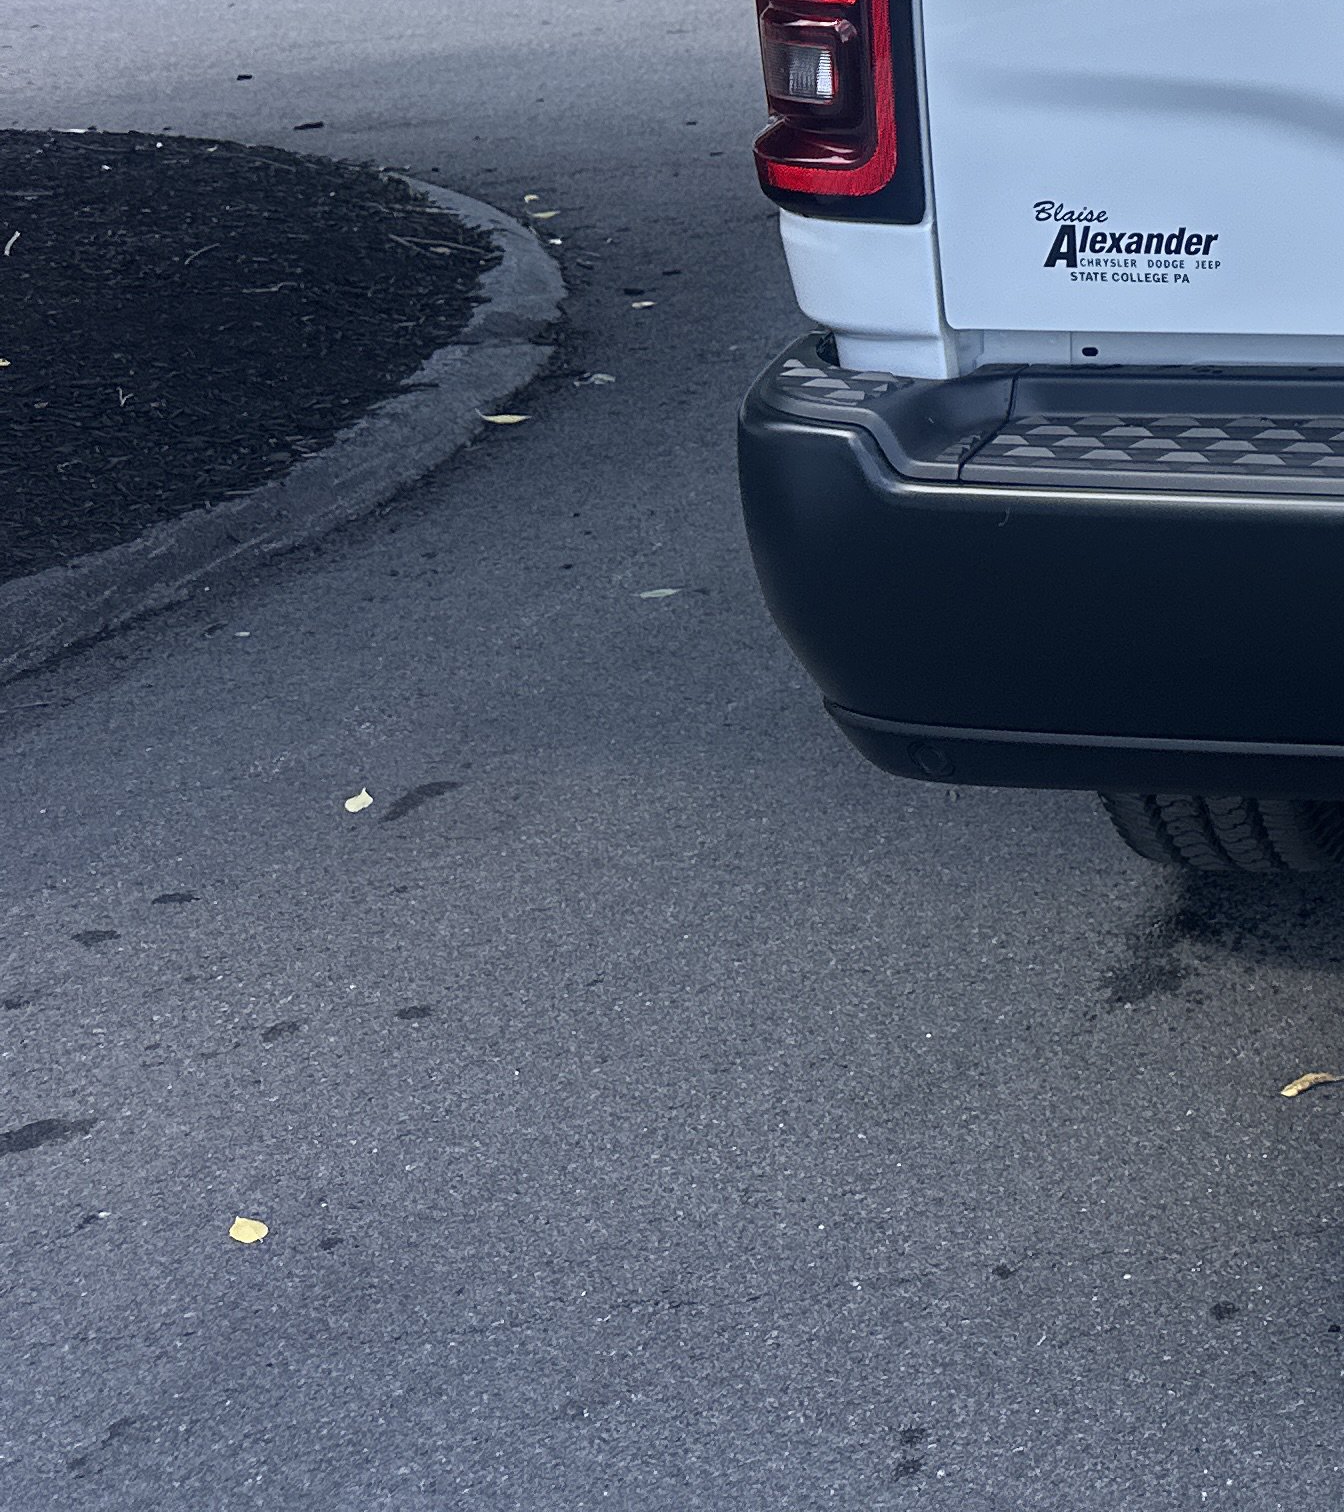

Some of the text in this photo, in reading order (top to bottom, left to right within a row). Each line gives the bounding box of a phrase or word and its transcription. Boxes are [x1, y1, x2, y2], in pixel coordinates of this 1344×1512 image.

[1033, 200, 1108, 223] Blaise
[1043, 224, 1219, 268] Alexander
[1079, 258, 1221, 270] CHRYSLER DODGE JEEP
[1070, 271, 1190, 284] STATE COLLEGE PA
